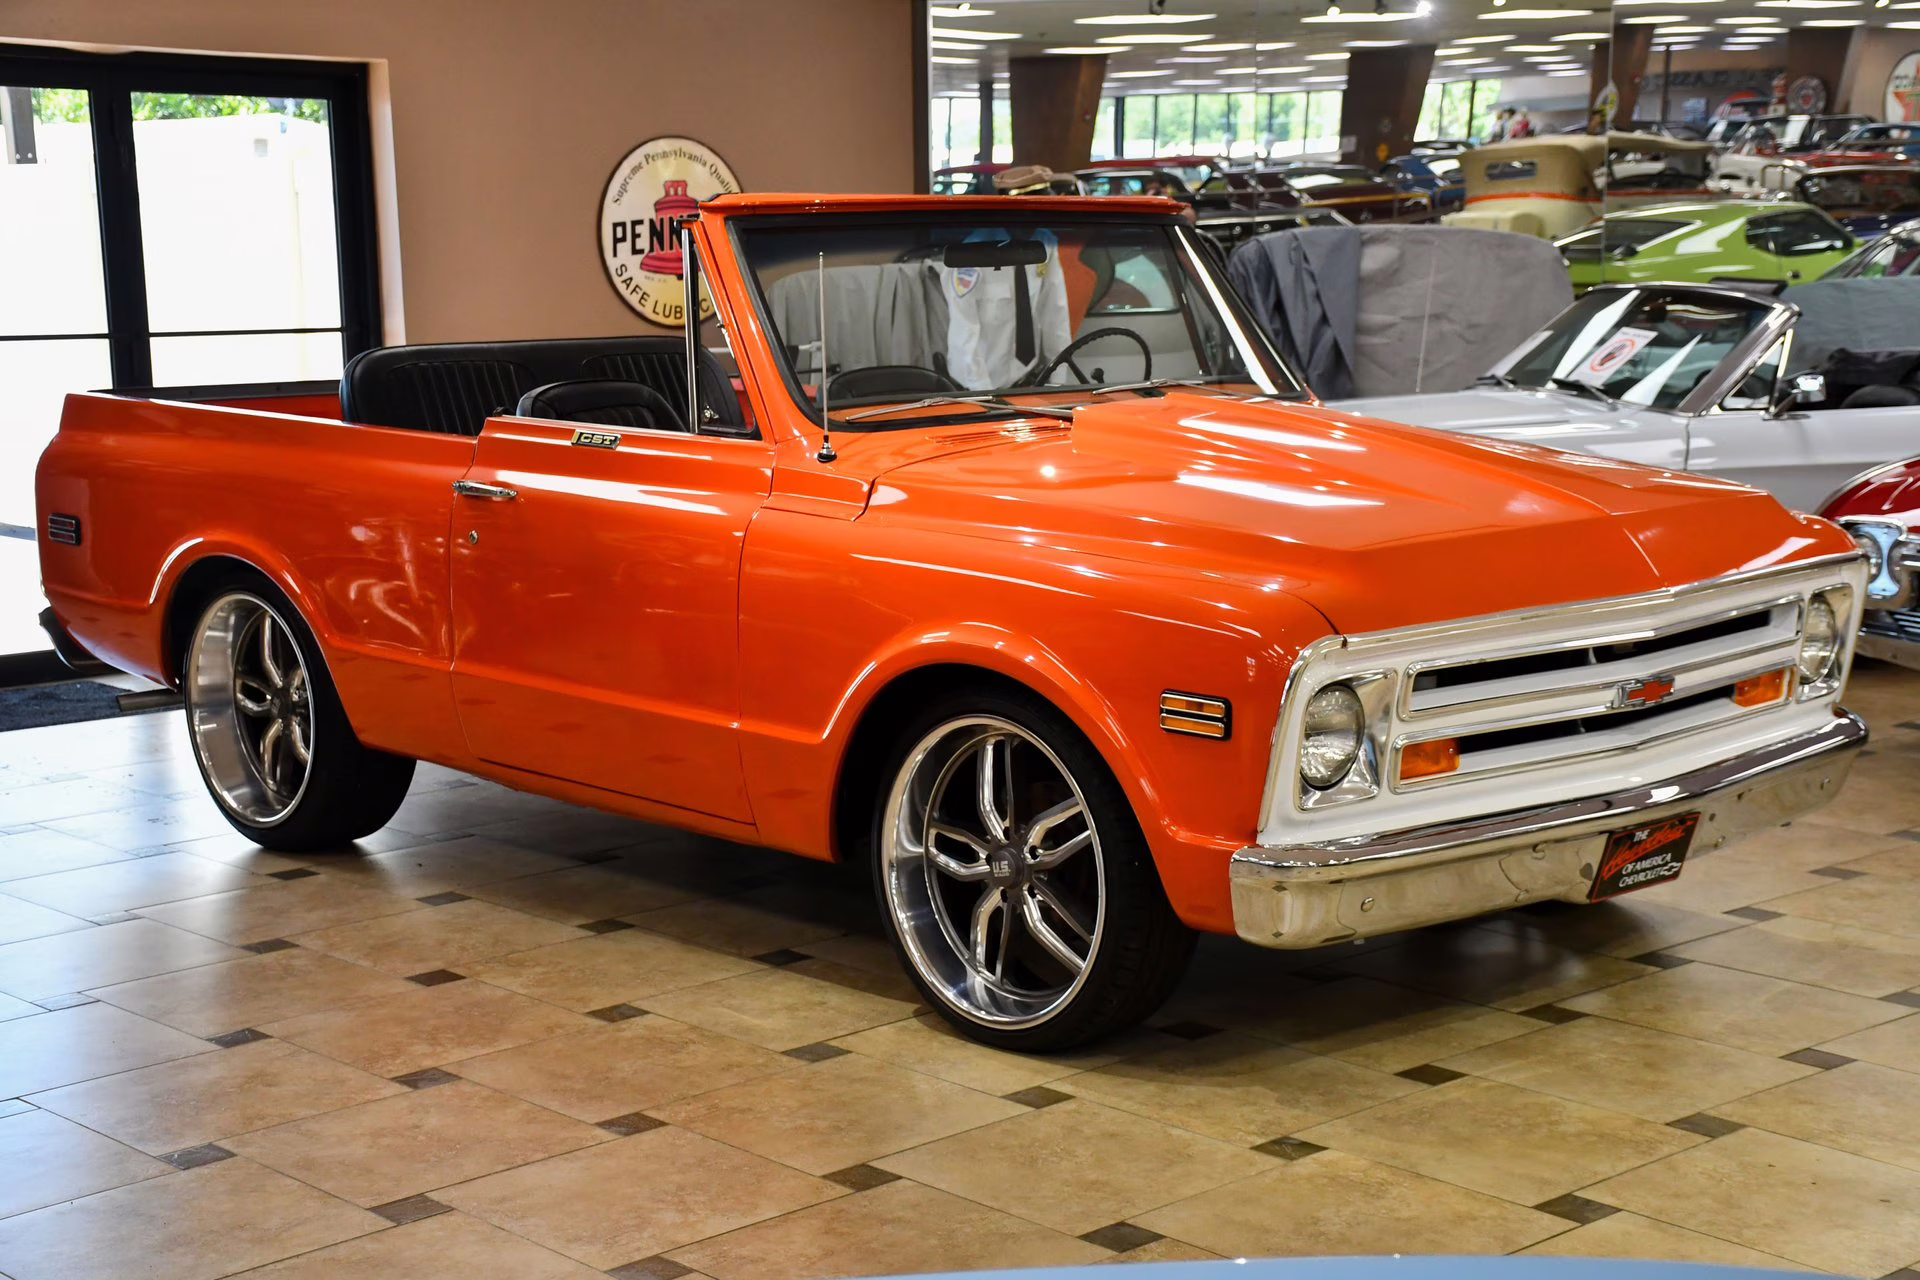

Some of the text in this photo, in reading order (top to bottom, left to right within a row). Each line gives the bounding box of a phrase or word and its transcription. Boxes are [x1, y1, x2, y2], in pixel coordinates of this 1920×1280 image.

[612, 161, 644, 206] Supreme
[644, 147, 708, 169] Pennsylvania
[615, 263, 651, 308] SAFE
[580, 433, 616, 445] CST
[1633, 829, 1651, 842] THE
[1621, 853, 1672, 875] OF AMERICA
[1618, 866, 1663, 888] CHEVROLET
